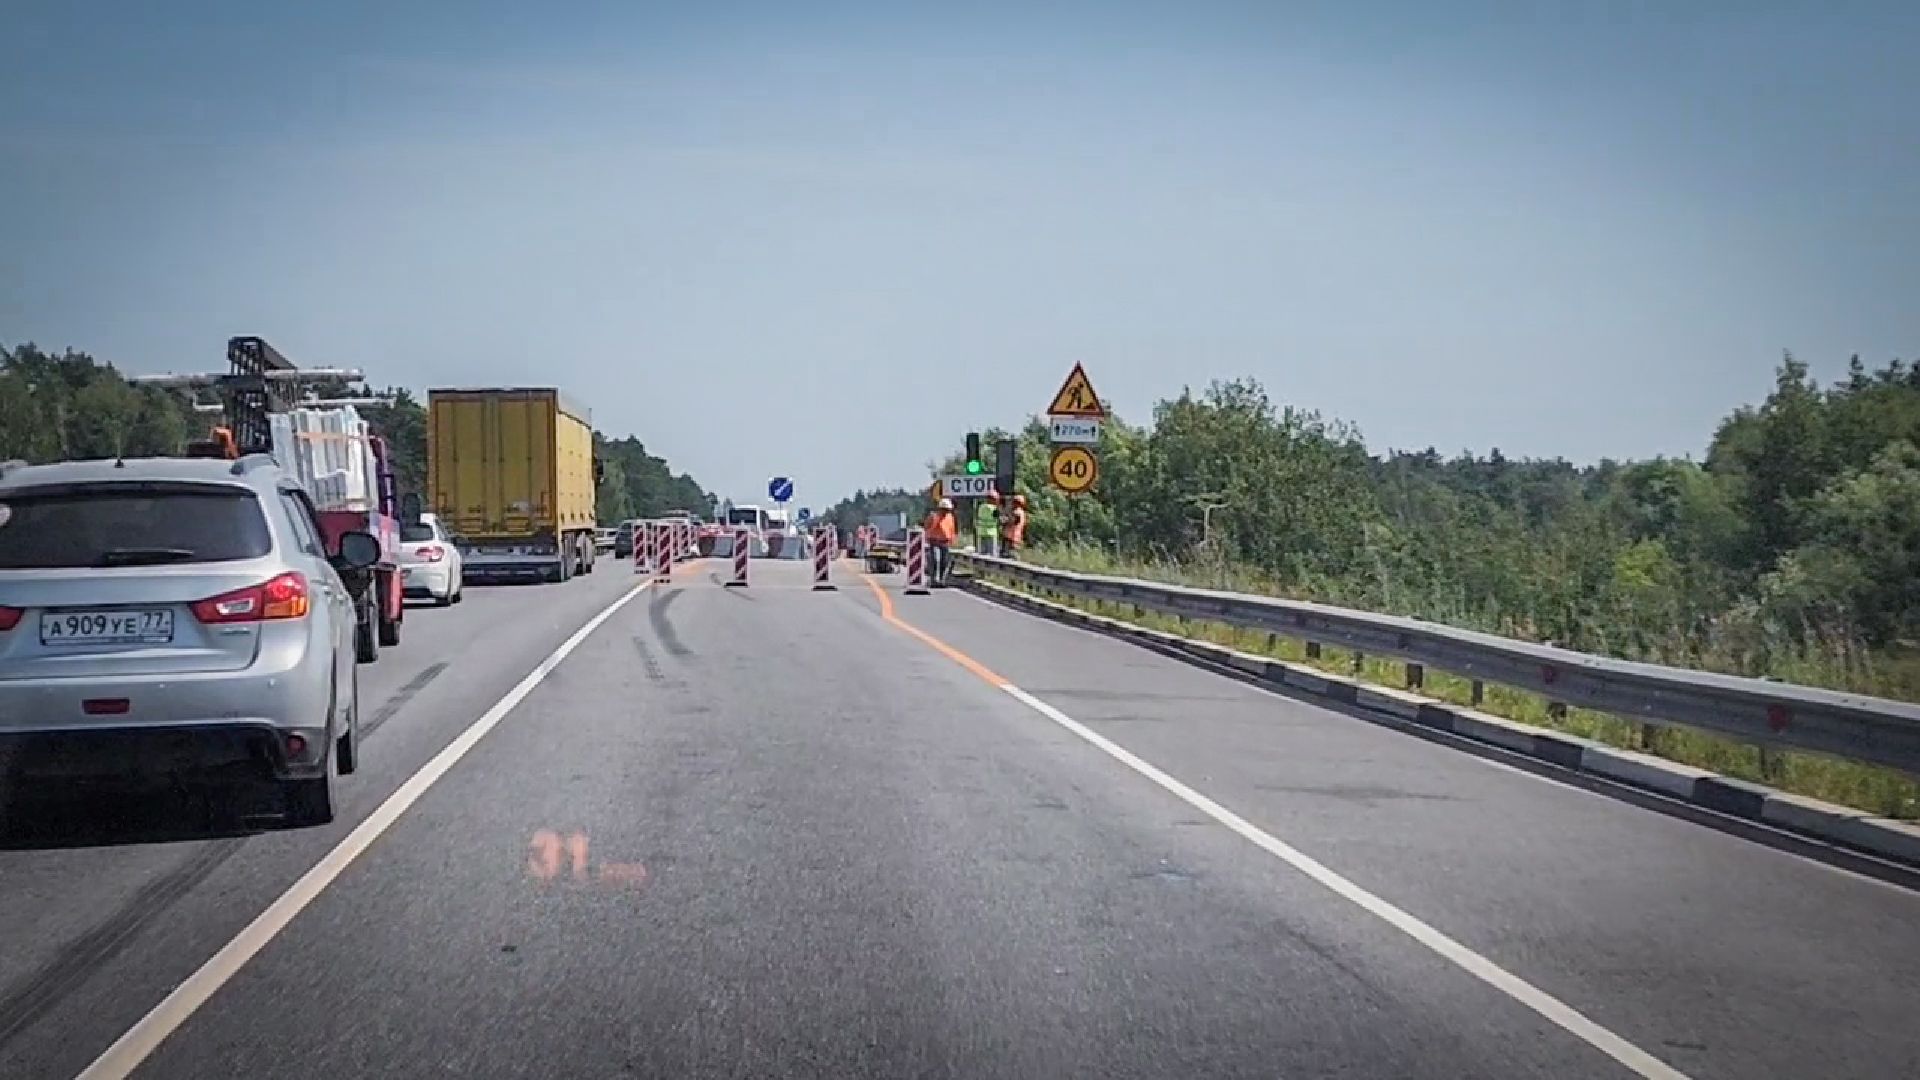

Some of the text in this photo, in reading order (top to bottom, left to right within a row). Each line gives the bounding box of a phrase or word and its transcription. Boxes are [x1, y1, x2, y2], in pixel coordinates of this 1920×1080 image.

[1059, 459, 1088, 478] 40
[951, 478, 998, 494] СТОП
[143, 612, 164, 629] 77
